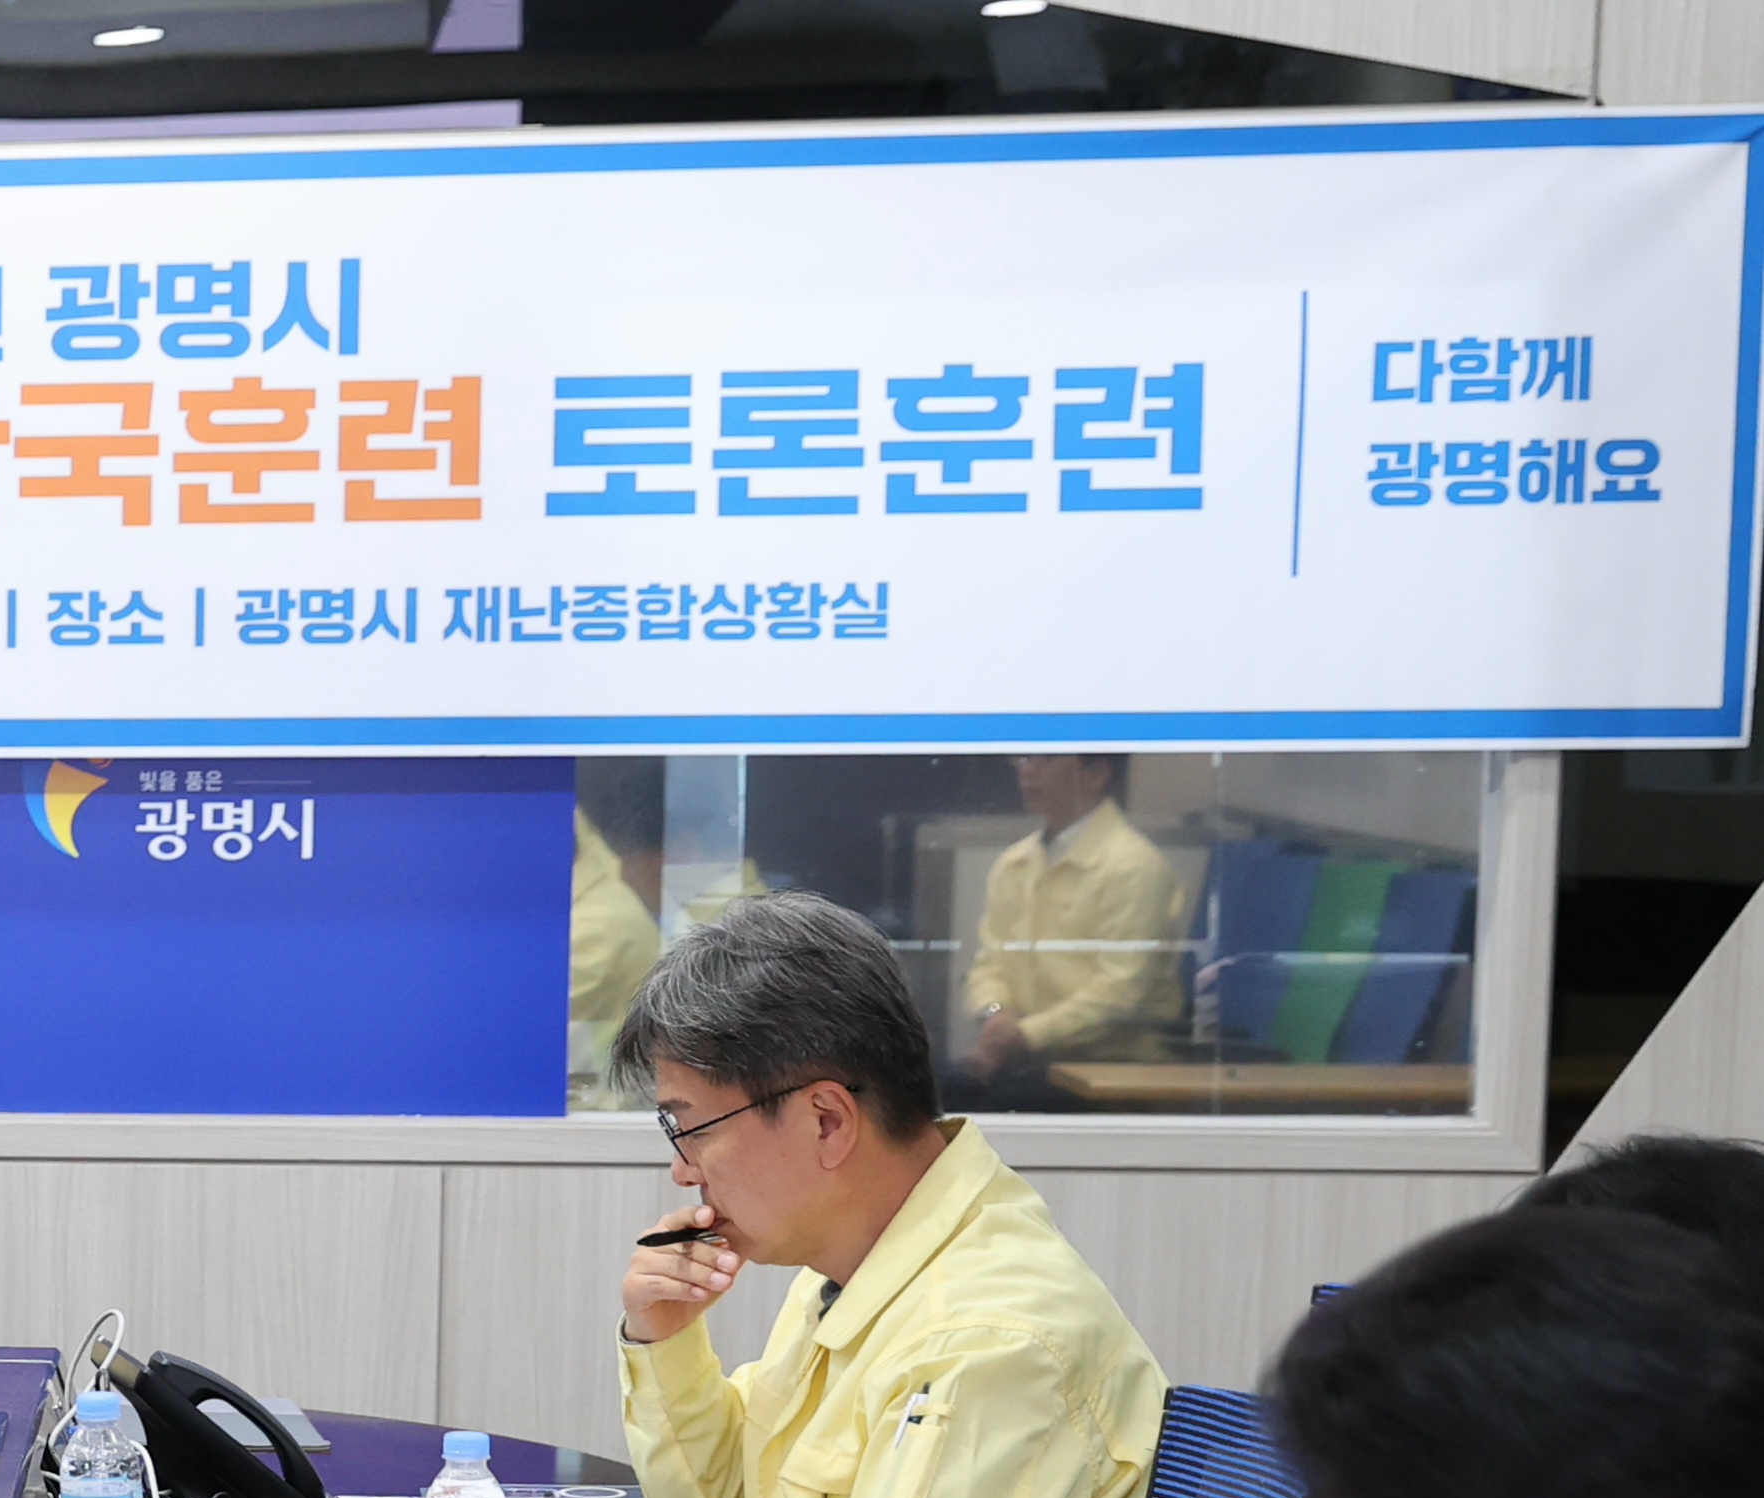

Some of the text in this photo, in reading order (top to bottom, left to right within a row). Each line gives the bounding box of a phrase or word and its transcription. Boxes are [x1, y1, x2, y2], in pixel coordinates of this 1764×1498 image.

[46, 258, 362, 362] 광명시
[1372, 336, 1594, 406] 다함께
[545, 362, 1207, 518] 토론훈련
[1366, 439, 1663, 508] 광명해요
[47, 582, 890, 648] 장소 광명시 재난종합상황실
[139, 770, 224, 793] 빛을 품은
[135, 798, 315, 862] 광명시
